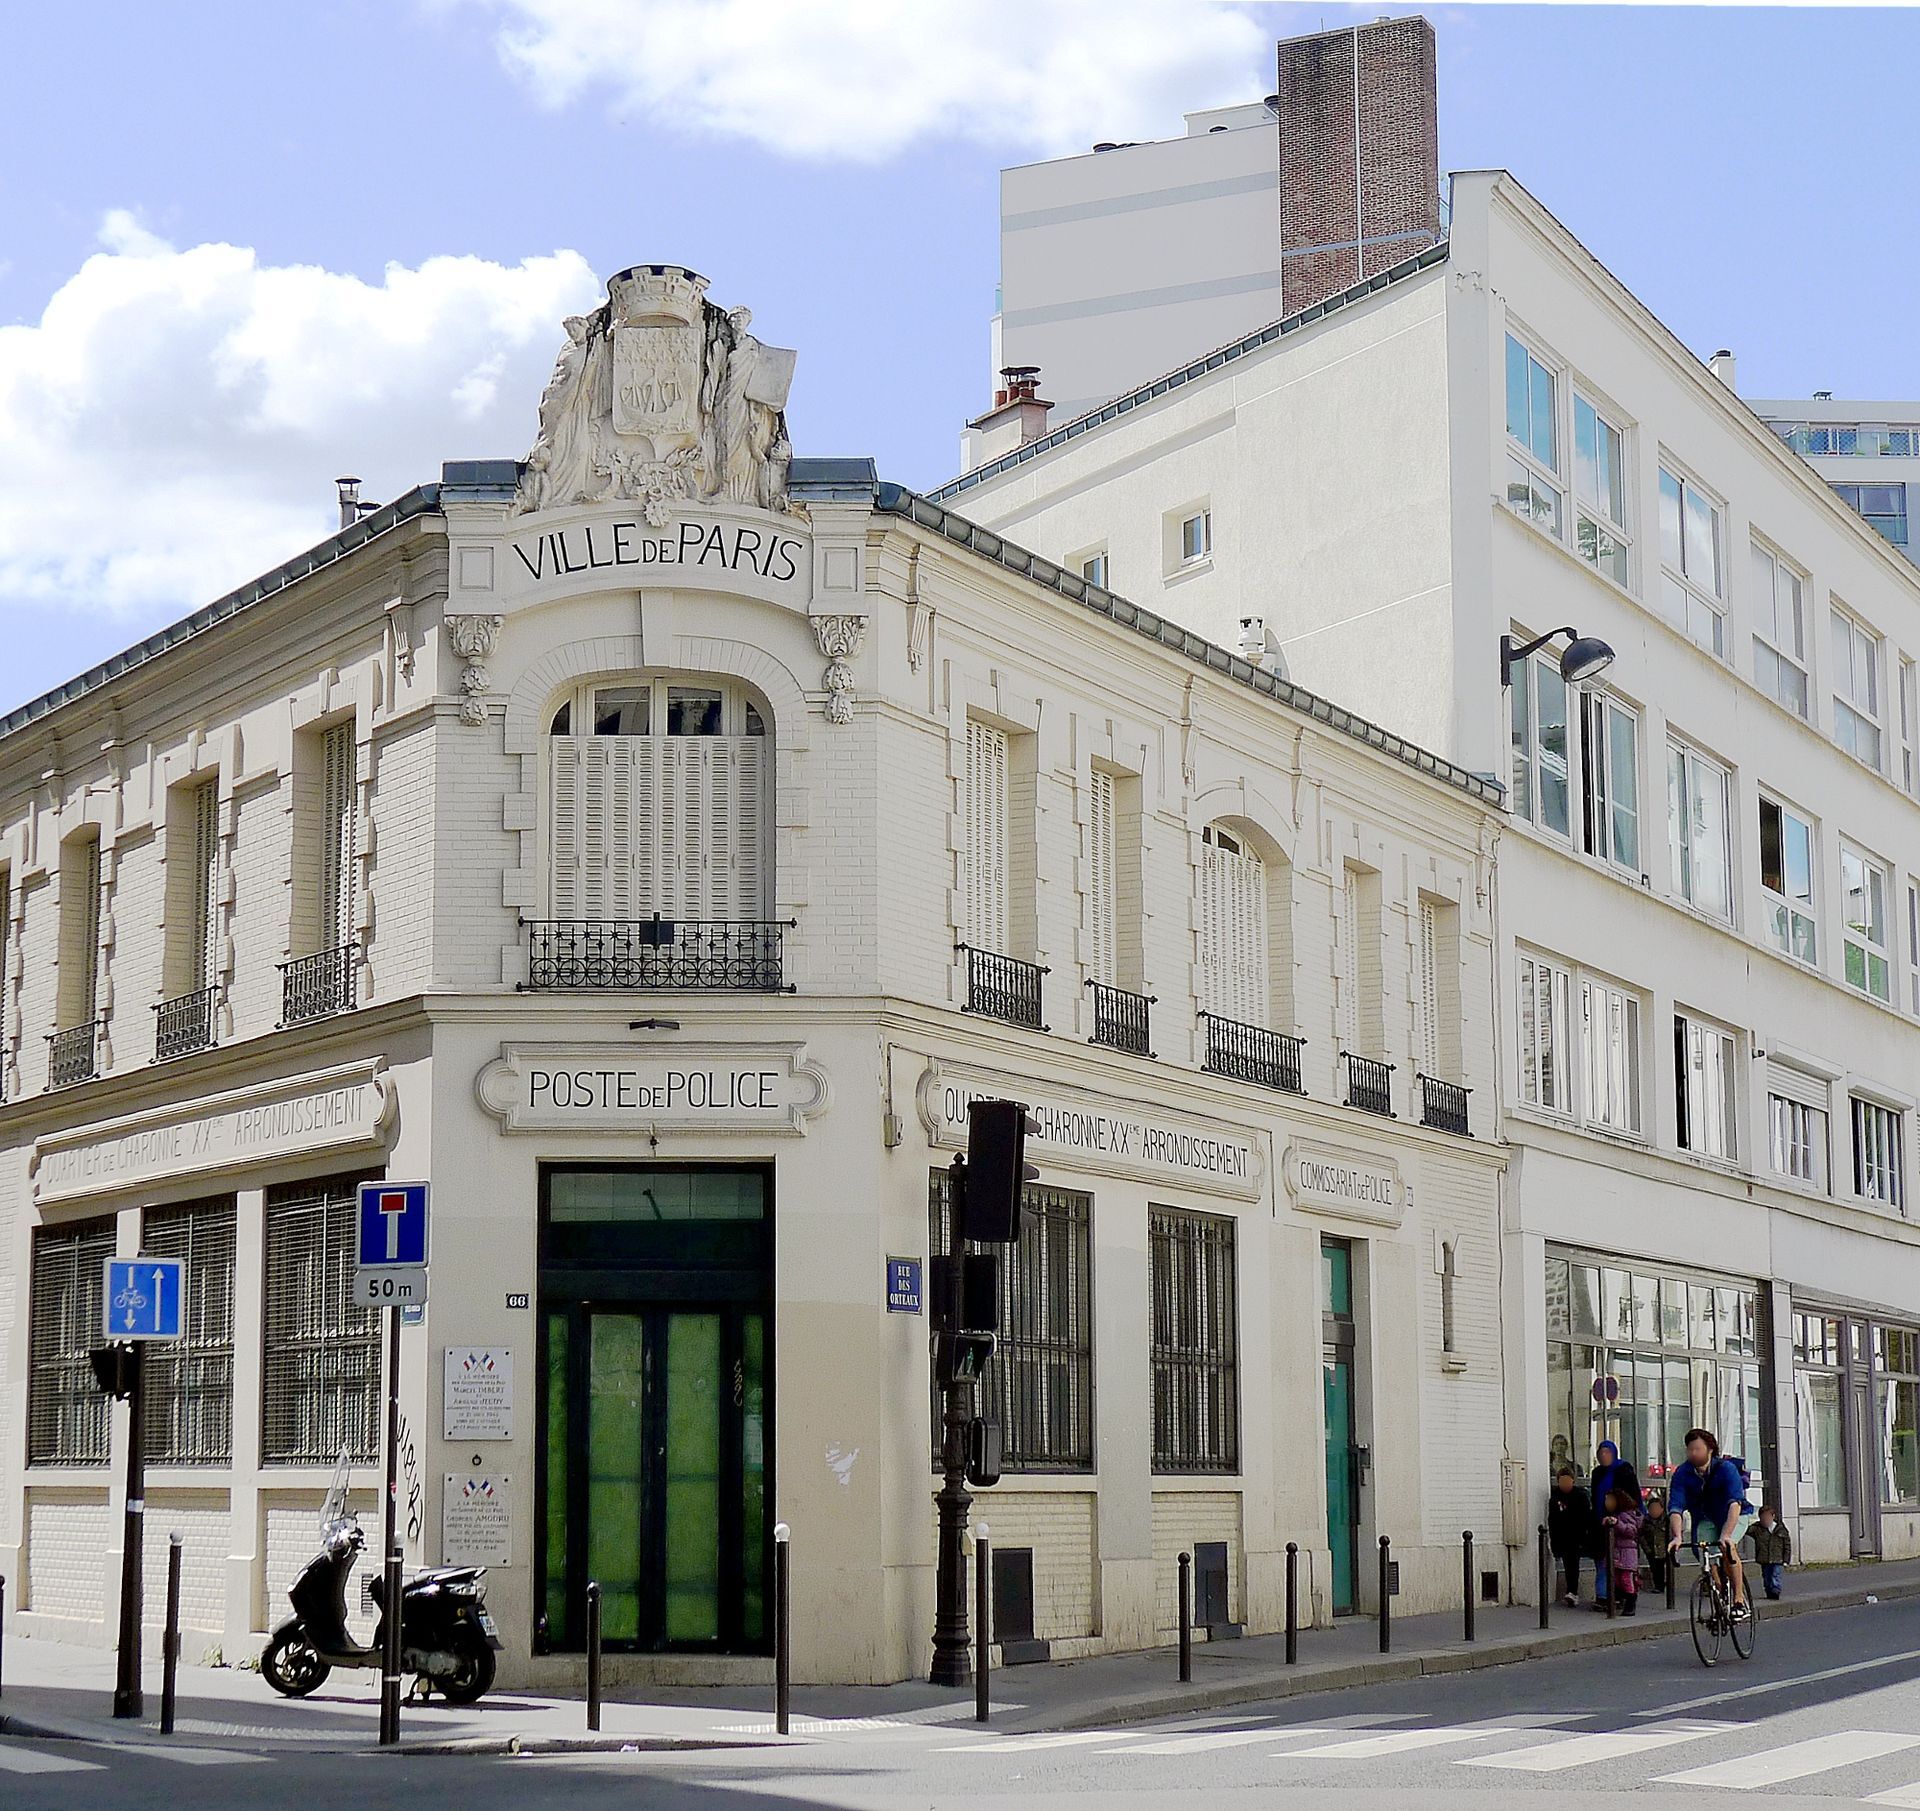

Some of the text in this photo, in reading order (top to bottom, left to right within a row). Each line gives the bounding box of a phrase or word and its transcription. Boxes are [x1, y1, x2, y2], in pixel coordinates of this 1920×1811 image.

[512, 522, 803, 581] VILLE DE PARIS
[530, 1071, 779, 1108] POSTE DE POLICE
[47, 1144, 102, 1184] QUARTIER
[103, 1153, 115, 1173] DE
[116, 1127, 182, 1169] CHARONNE
[233, 1086, 366, 1147] ARRONDISSEMENT
[1035, 1105, 1107, 1152] CHARONNE
[1142, 1127, 1249, 1178] ARRONDISSEMENT
[1300, 1160, 1358, 1199] COMMISSARIAT
[1365, 1174, 1392, 1206] POLICE
[897, 1265, 911, 1277] RUE
[898, 1279, 911, 1291] DES
[368, 1279, 412, 1298] 50 m
[508, 1295, 526, 1307] 66
[889, 1293, 919, 1306] ORTEAUX
